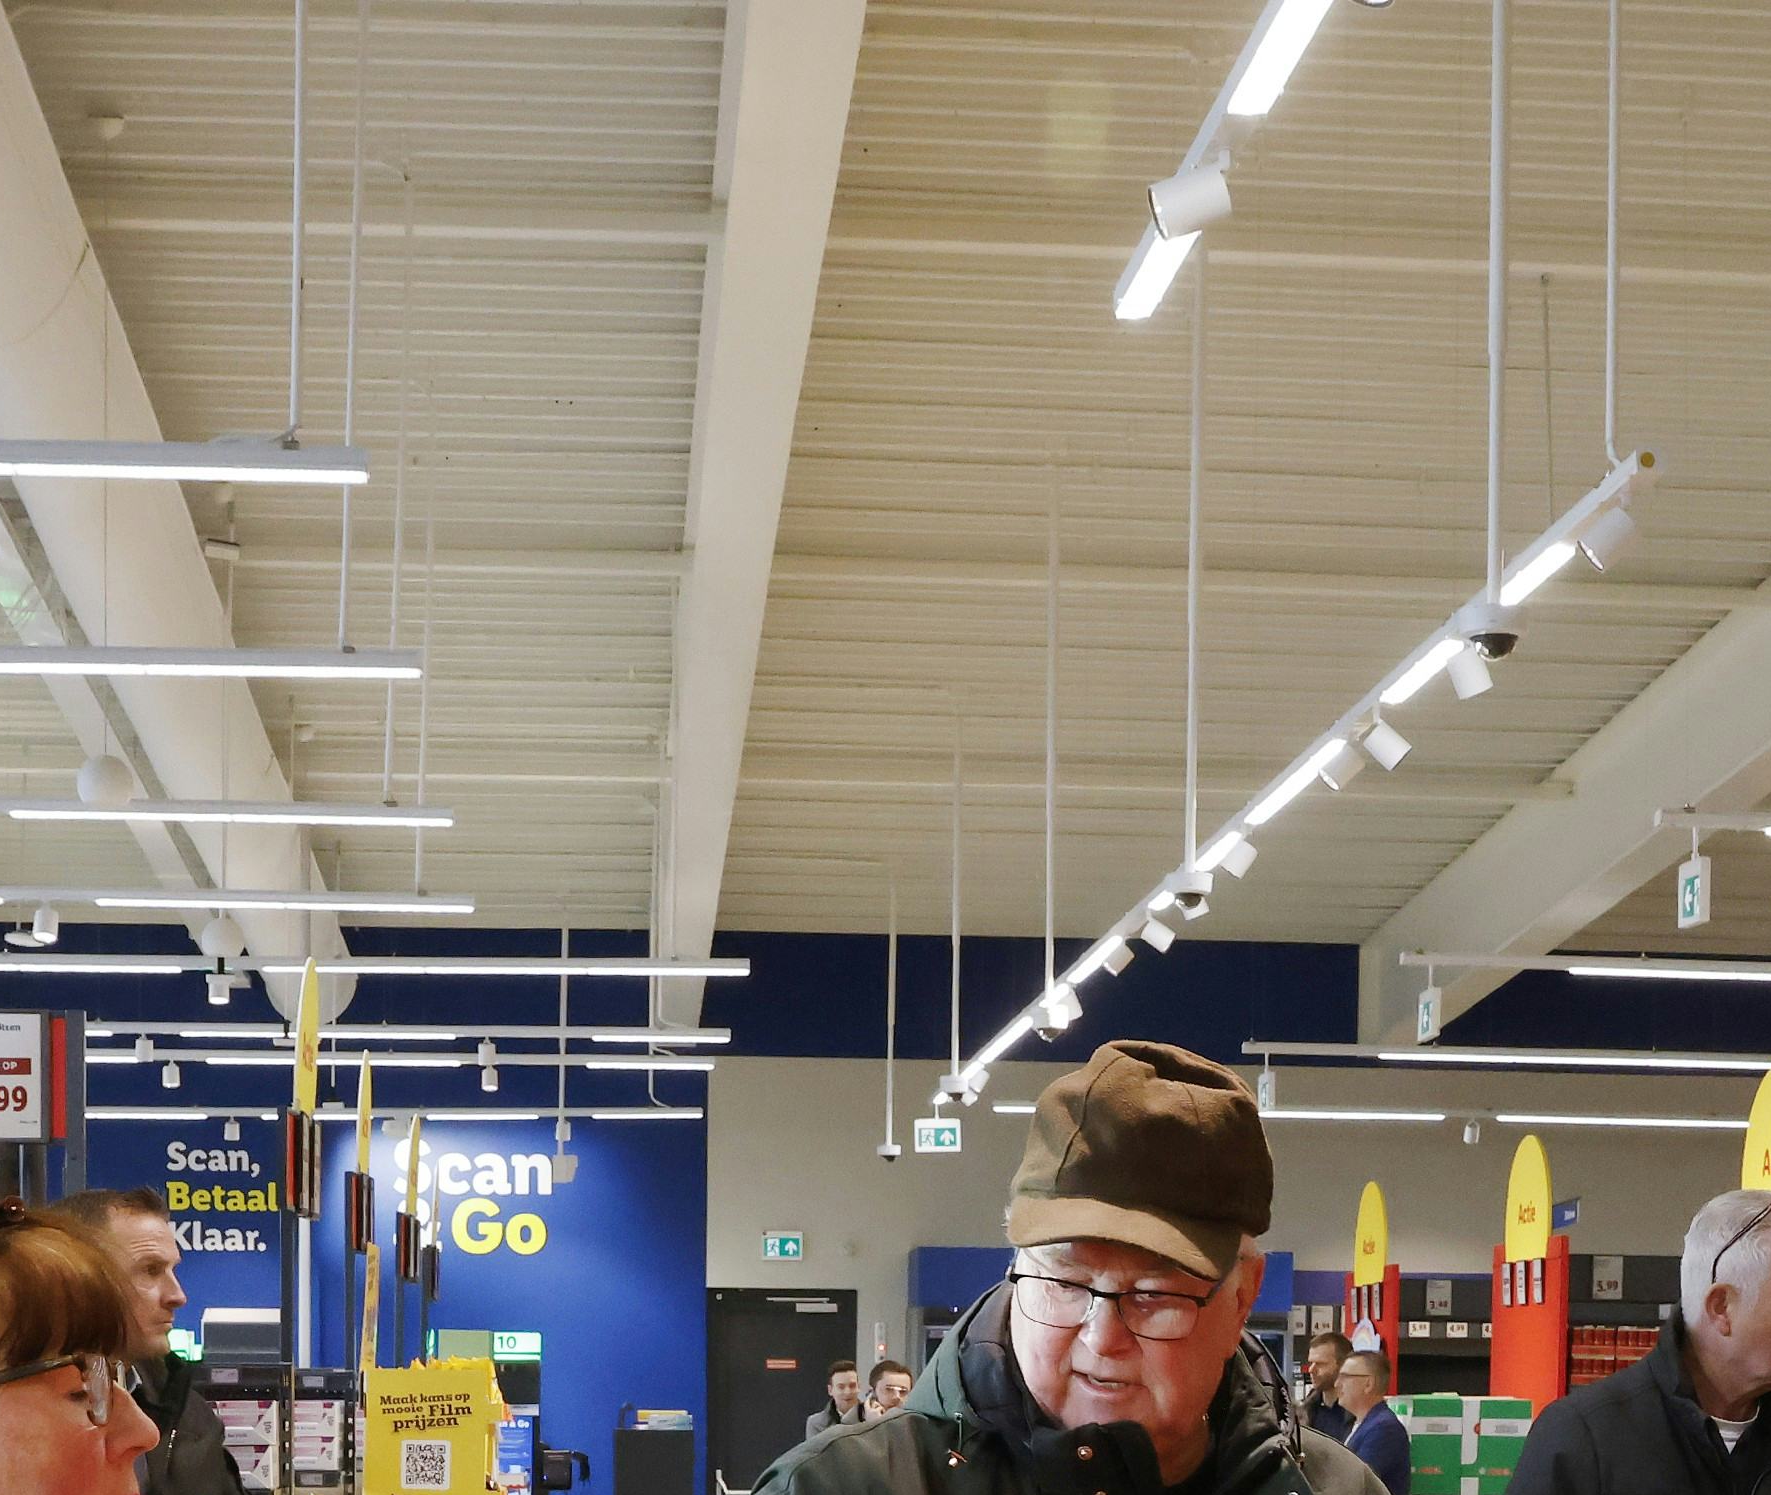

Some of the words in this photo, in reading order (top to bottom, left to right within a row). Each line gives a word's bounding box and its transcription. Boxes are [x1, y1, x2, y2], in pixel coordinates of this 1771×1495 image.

[2, 1061, 18, 1070] OP
[166, 1141, 260, 1177] Scan,
[393, 1138, 553, 1196] Scan
[166, 1181, 279, 1212] Betaal
[1518, 1200, 1536, 1225] Actie
[168, 1220, 267, 1252] Klaar.
[451, 1197, 549, 1256] Go
[497, 1335, 517, 1349] 10
[380, 1394, 418, 1406] Maak
[420, 1393, 453, 1403] kans
[454, 1393, 470, 1403] op
[382, 1404, 424, 1415] mooie
[429, 1404, 472, 1417] Film
[393, 1417, 459, 1432] prijzen
